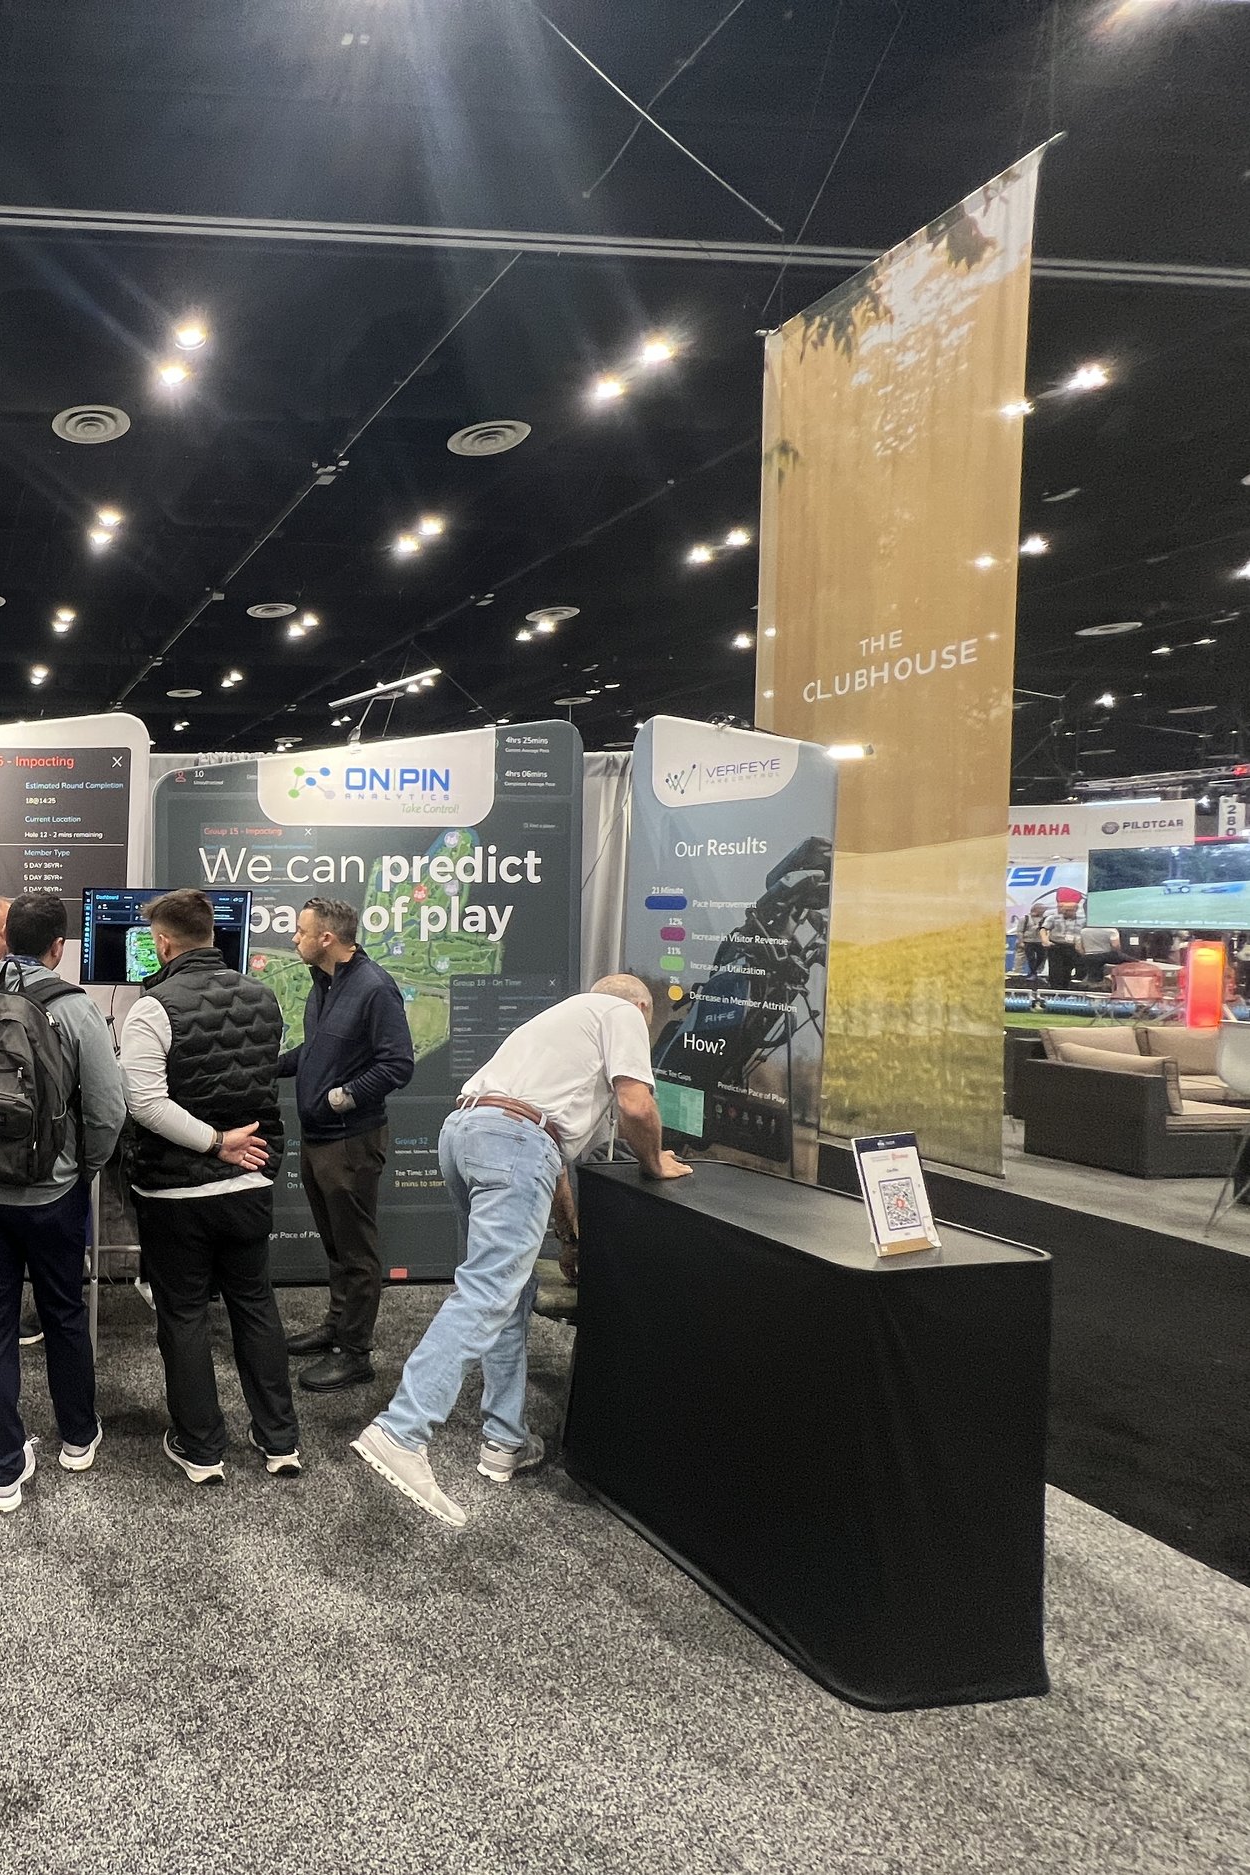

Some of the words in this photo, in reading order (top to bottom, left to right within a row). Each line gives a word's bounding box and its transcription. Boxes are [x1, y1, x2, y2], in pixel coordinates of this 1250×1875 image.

[859, 629, 903, 657] THE
[803, 638, 978, 703] CLUBHOUSE
[15, 755, 75, 769] Impacting
[194, 770, 205, 778] 10
[706, 758, 781, 779] VERIFEYE
[25, 782, 60, 790] Estimated
[61, 782, 84, 790] Round
[85, 782, 124, 790] Completion
[345, 793, 450, 801] ANALYTICS
[401, 803, 421, 813] Take
[423, 803, 459, 814] Control!
[25, 815, 50, 823] Current
[52, 815, 82, 823] Location
[1122, 819, 1184, 830] PILOTCAR
[73, 831, 104, 840] remaining
[204, 827, 227, 837] Group
[229, 827, 239, 835] 15
[246, 827, 283, 837] Impacting
[675, 841, 703, 858] Our
[707, 836, 767, 857] Results
[53, 849, 70, 857] Type
[199, 847, 272, 884] We
[286, 854, 365, 884] can
[381, 844, 542, 893] predict
[660, 887, 684, 895] Minute
[692, 900, 709, 908] Pace
[709, 900, 758, 909] Improvement
[362, 895, 410, 933] of
[420, 895, 514, 942] play
[692, 932, 721, 942] Increase
[730, 934, 753, 944] Visitor
[755, 936, 789, 945] Revenue
[690, 961, 719, 972] Increase
[727, 964, 765, 976] Utilization
[689, 992, 721, 1003] Decrease
[730, 995, 761, 1008] Member
[762, 999, 798, 1013] Attrition
[683, 1032, 727, 1056] How?
[395, 1137, 417, 1147] Group
[419, 1137, 428, 1145] 32
[280, 1231, 298, 1239] Pace
[299, 1231, 307, 1239] of
